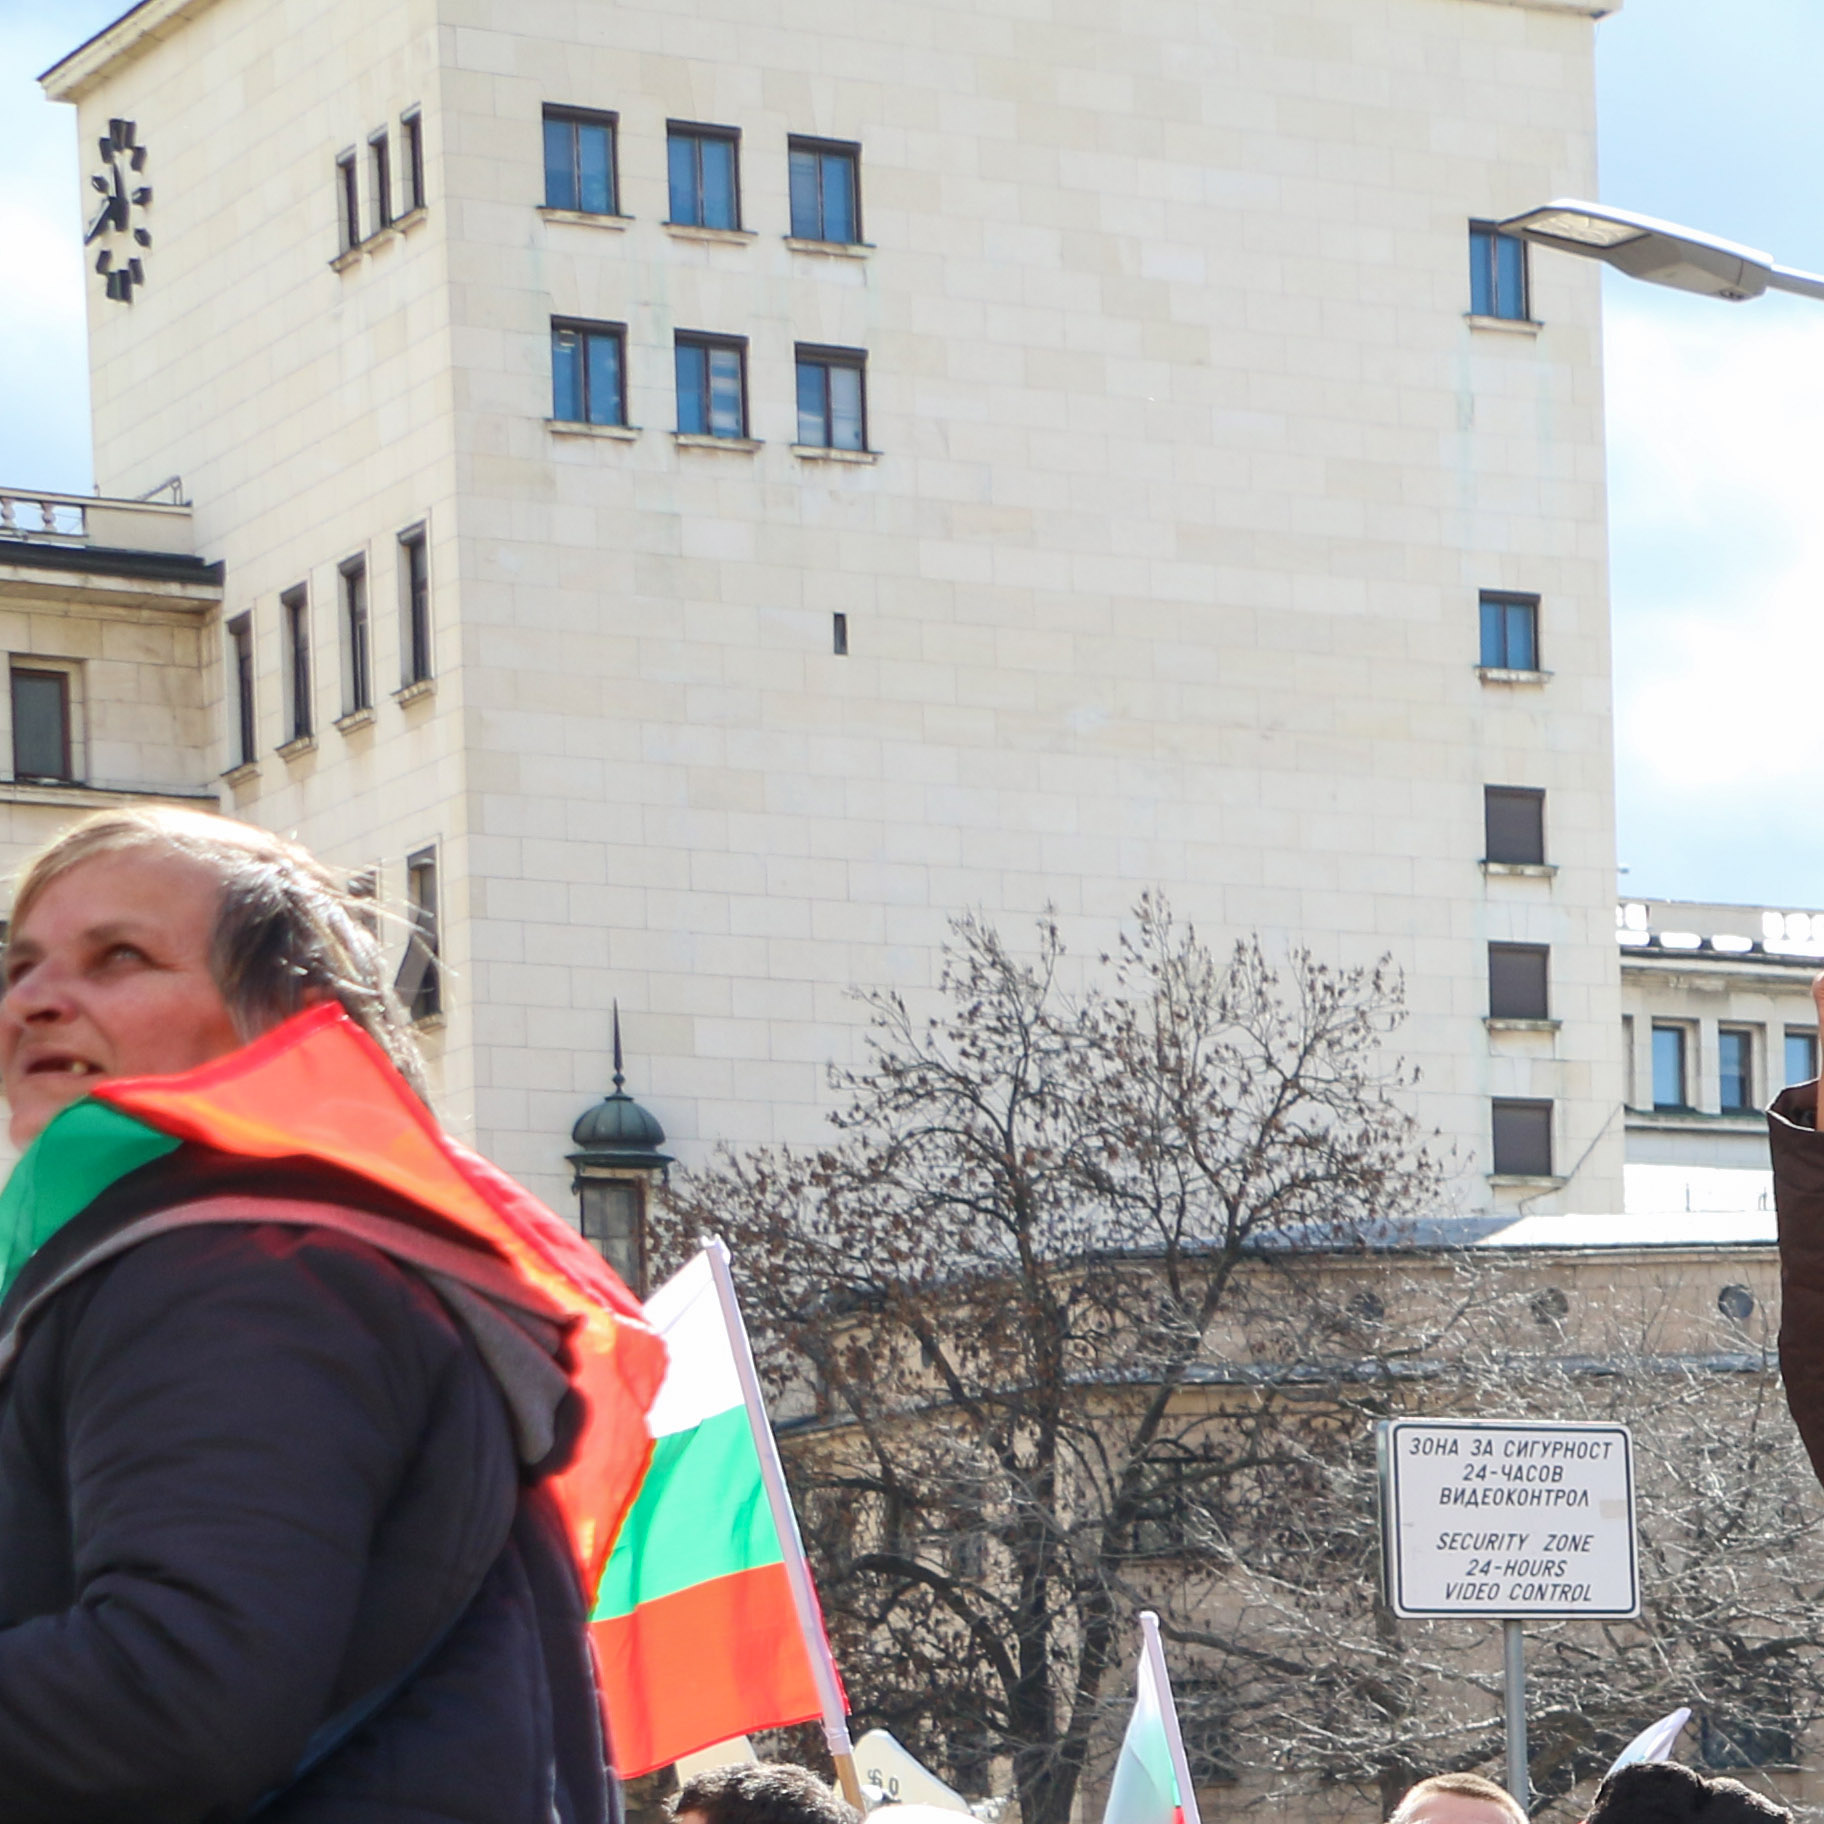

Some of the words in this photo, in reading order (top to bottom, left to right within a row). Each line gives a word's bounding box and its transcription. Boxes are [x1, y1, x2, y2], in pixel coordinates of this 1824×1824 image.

[1408, 1437, 1459, 1456] ЗОНА
[1470, 1439, 1494, 1457] ЗА
[1503, 1439, 1613, 1460] СИГУРНОСТ
[1462, 1463, 1564, 1483] 24-ЧАСОВ
[1439, 1487, 1590, 1509] ВИДЕОКОНТРОЛ
[1436, 1532, 1530, 1551] SECURITY
[1543, 1534, 1595, 1553] ZONE
[1465, 1558, 1568, 1578] 24-HOURS
[1444, 1582, 1500, 1601] VIDEO
[1509, 1583, 1593, 1602] CONTROL
